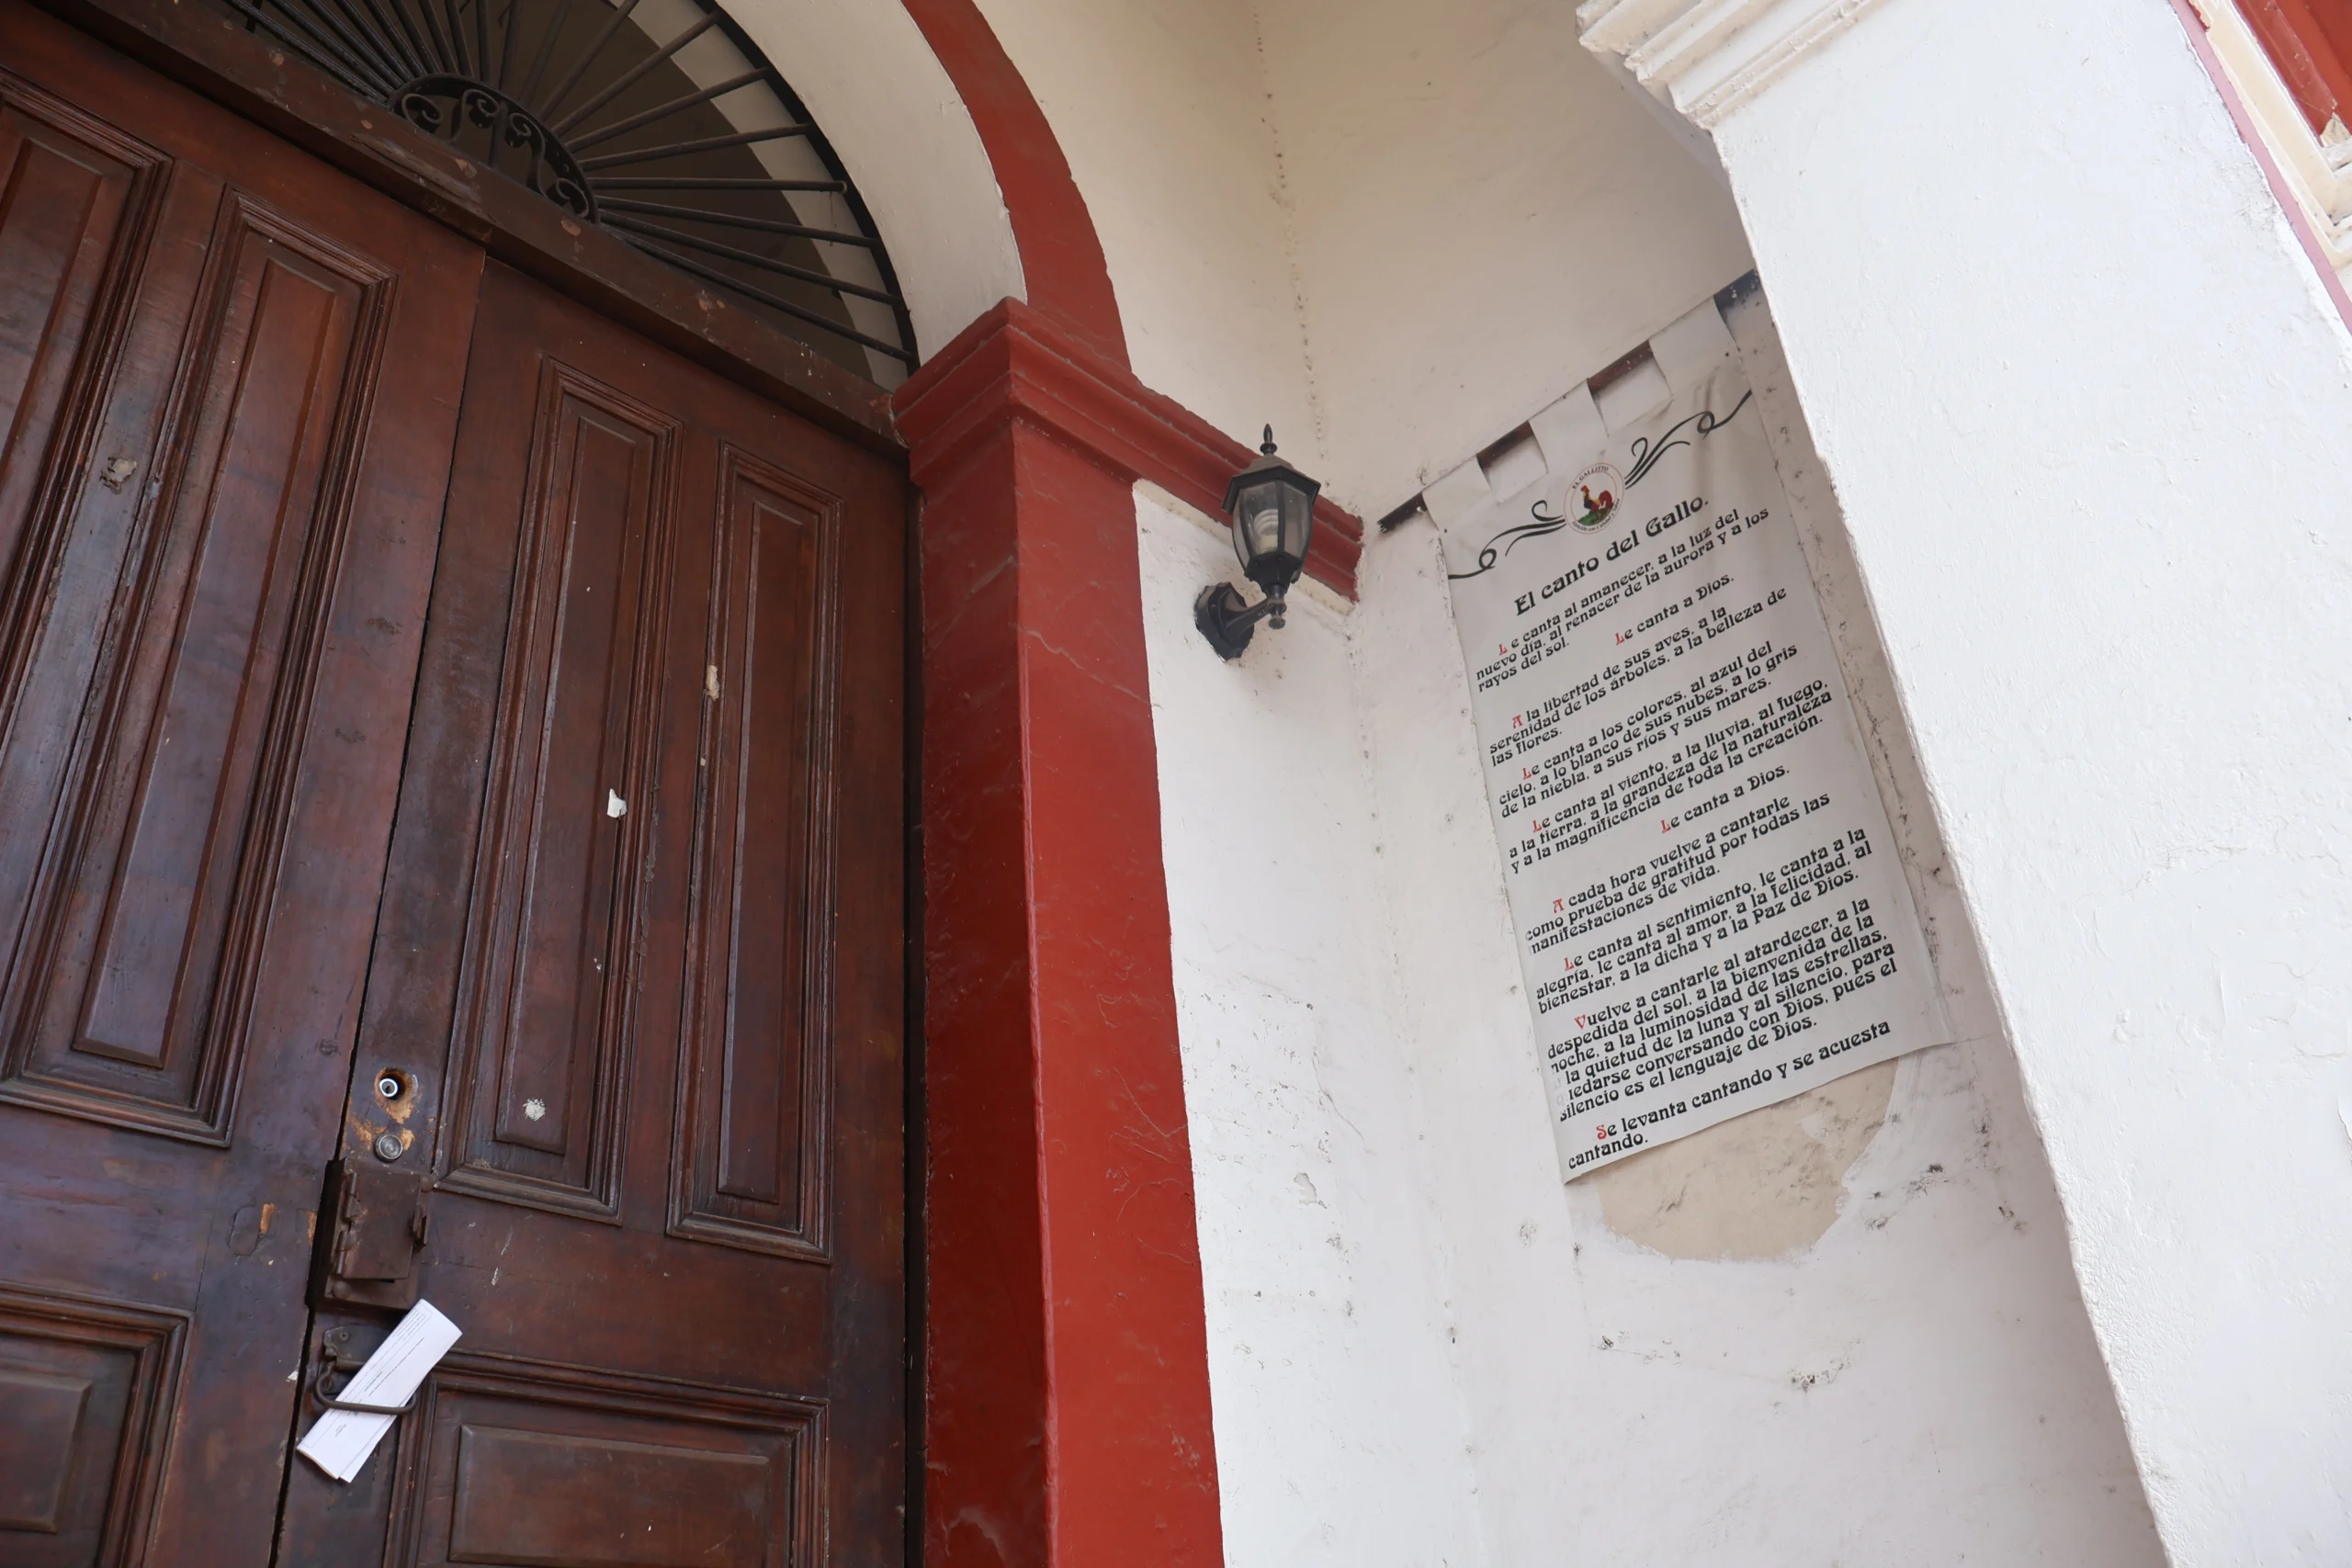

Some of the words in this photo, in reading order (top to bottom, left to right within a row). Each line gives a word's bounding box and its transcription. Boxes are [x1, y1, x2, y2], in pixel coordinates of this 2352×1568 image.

[1476, 653, 1517, 681] nuevo
[1549, 625, 1563, 641] al
[1566, 593, 1620, 632] renacer
[1624, 581, 1642, 598] de
[1645, 571, 1660, 586] la
[1664, 540, 1714, 575] aurora
[1717, 531, 1726, 545] y
[1731, 525, 1742, 536] a
[1745, 509, 1769, 528] los
[1514, 591, 1536, 616] El
[1541, 558, 1600, 600] canto
[1606, 529, 1640, 561] del
[1645, 497, 1709, 537] Gallo.
[1615, 629, 1634, 646] Le
[1637, 604, 1679, 633] canta
[1683, 596, 1693, 608] a
[1695, 574, 1734, 601] Dios.
[1478, 666, 1517, 693] rayos
[1521, 650, 1543, 670] del
[1545, 637, 1569, 657] sol.
[1489, 709, 1561, 754] serenidad
[1565, 701, 1582, 716] de
[1585, 687, 1606, 705] los
[1673, 645, 1684, 657] a
[1687, 636, 1702, 649] la
[1705, 603, 1763, 639] belleza
[1767, 588, 1787, 605] de
[1512, 715, 1523, 728] A
[1526, 709, 1541, 722] la
[1544, 673, 1600, 714] libertad
[1602, 664, 1621, 681] de
[1624, 649, 1651, 669] sus
[1698, 617, 1708, 629] a
[1711, 606, 1726, 622] la
[1522, 764, 1540, 780] Le
[1544, 742, 1585, 769] canta
[1589, 736, 1598, 748] a
[1600, 722, 1623, 740] los
[1690, 676, 1706, 694] al
[1709, 656, 1744, 683] azul
[1747, 640, 1772, 663] del
[1491, 750, 1513, 767] las
[1516, 728, 1562, 754] flores.
[1501, 803, 1519, 818] de
[1521, 795, 1537, 808] la
[1593, 762, 1603, 774] a
[1606, 747, 1633, 768] sus
[1636, 729, 1667, 752] ríos
[1669, 722, 1679, 736] y
[1683, 706, 1712, 728] sus
[1715, 678, 1771, 711] mares.
[1510, 861, 1520, 874] y
[1523, 854, 1533, 866] a
[1536, 847, 1552, 861] la
[1555, 795, 1661, 852] magnificencia
[1665, 783, 1684, 799] de
[1688, 763, 1724, 788] toda
[1726, 753, 1744, 769] la
[1747, 715, 1823, 758] creación.
[1532, 818, 1551, 833] Le
[1555, 795, 1597, 822] canta
[1600, 784, 1615, 801] al
[1672, 752, 1682, 764] a
[1685, 742, 1702, 758] la
[1758, 703, 1775, 720] al
[1661, 817, 1680, 833] Le
[1684, 793, 1730, 821] canta
[1734, 785, 1745, 797] a
[1747, 765, 1790, 791] Dios.
[1525, 917, 1564, 941] como
[1568, 891, 1623, 926] prueba
[1628, 881, 1647, 897] de
[1651, 845, 1716, 889] gratitud
[1719, 833, 1747, 858] por
[1751, 808, 1800, 840] todas
[1803, 794, 1830, 815] las
[1553, 898, 1565, 914] A
[1568, 883, 1607, 907] cada
[1610, 864, 1646, 889] hora
[1649, 839, 1702, 870] vuelve
[1705, 832, 1716, 844] a
[1720, 796, 1790, 837] cantarle
[1564, 955, 1583, 971] Le
[1588, 935, 1634, 962] canta
[1637, 924, 1653, 942] al
[1758, 871, 1776, 886] le
[1781, 847, 1829, 876] canta
[1833, 839, 1845, 852] a
[1847, 829, 1866, 845] la
[1597, 960, 1612, 974] le
[1617, 940, 1662, 966] canta
[1666, 927, 1682, 945] al
[1736, 902, 1747, 914] a
[1750, 892, 1768, 908] la
[1854, 840, 1872, 859] al
[1548, 1019, 1629, 1059] despedida
[1634, 1004, 1659, 1026] del
[1696, 987, 1707, 1000] a
[1710, 979, 1728, 995] la
[1730, 937, 1826, 986] bienvenida
[1831, 925, 1852, 942] de
[1856, 915, 1874, 931] la
[1574, 1001, 1632, 1030] Vuelve
[1635, 996, 1646, 1009] a
[1651, 965, 1720, 1002] cantarle
[1724, 953, 1740, 972] al
[1837, 908, 1849, 922] a
[1851, 898, 1871, 916] la
[1620, 969, 1631, 982] a
[1634, 961, 1650, 976] la
[1655, 940, 1699, 967] dicha
[1702, 933, 1712, 949] y
[1716, 927, 1728, 940] a
[1731, 918, 1749, 934] la
[1752, 901, 1786, 925] Paz
[1790, 890, 1812, 908] de
[1814, 870, 1859, 897] Dios.
[1560, 1089, 1619, 1122] silencio
[1624, 1081, 1645, 1097] es
[1649, 1070, 1665, 1089] el
[1668, 1044, 1743, 1082] lenguaje
[1747, 1033, 1769, 1051] de
[1771, 1016, 1817, 1042] Dios.
[1596, 1124, 1617, 1140] Se
[1621, 1101, 1688, 1133] levanta
[1691, 1069, 1772, 1109] cantando
[1776, 1063, 1787, 1079] y
[1792, 1053, 1815, 1071] se
[1818, 1021, 1891, 1060] acuesta
[1568, 1133, 1648, 1169] cantando.
